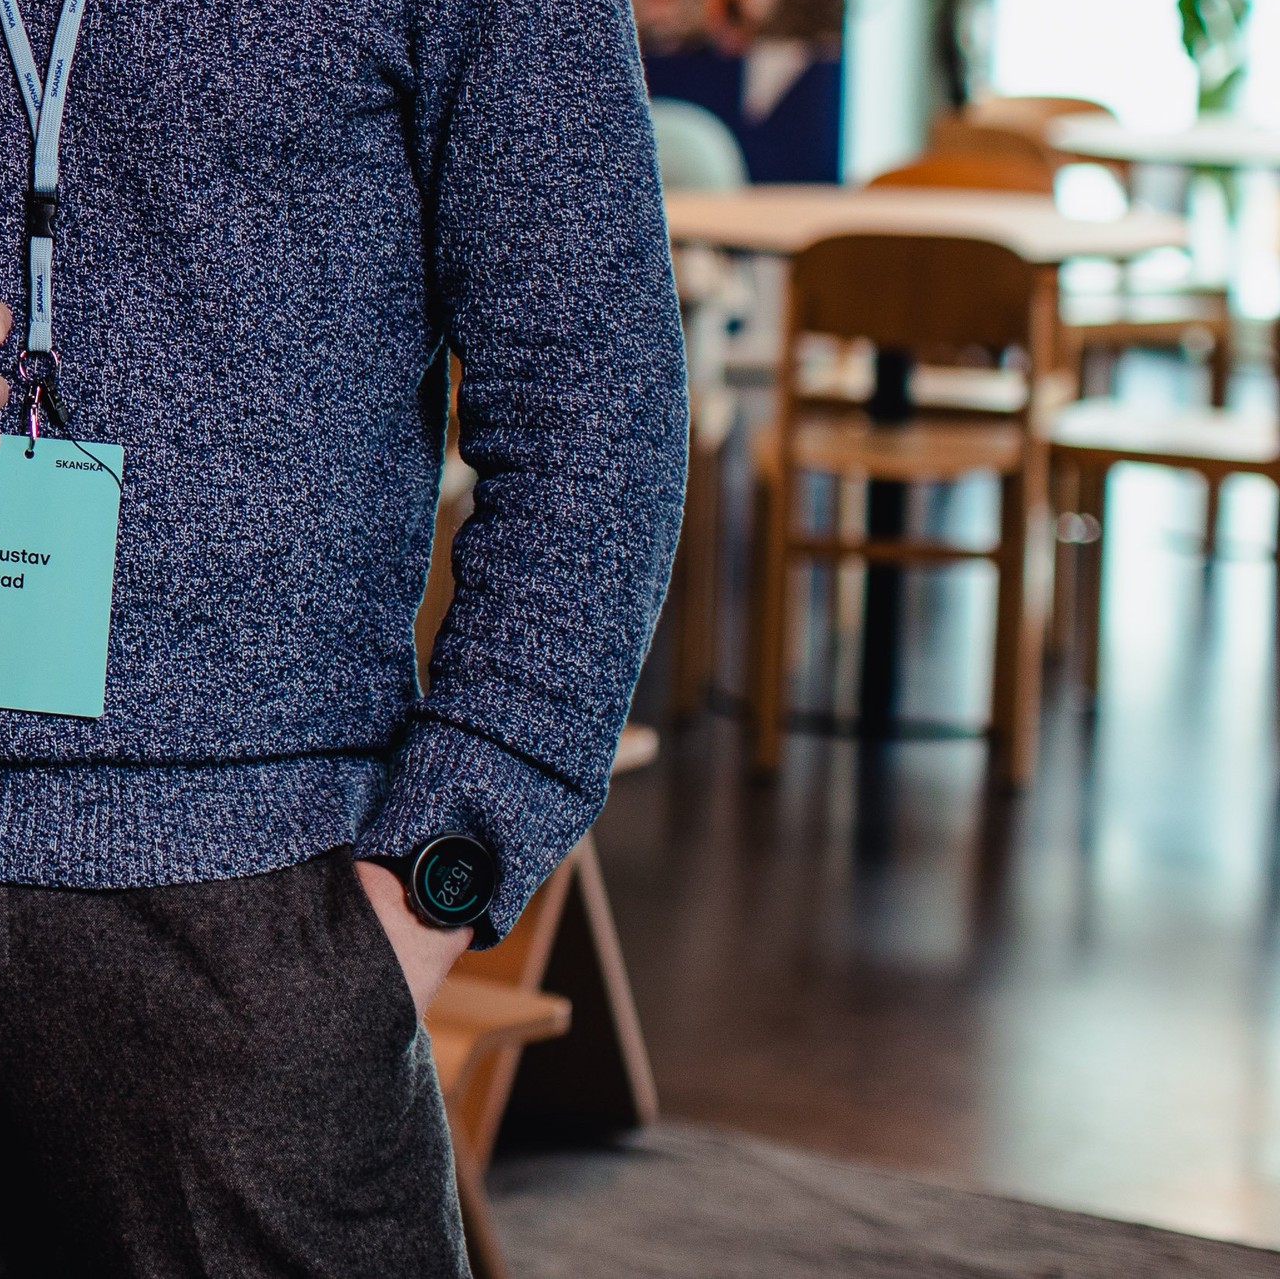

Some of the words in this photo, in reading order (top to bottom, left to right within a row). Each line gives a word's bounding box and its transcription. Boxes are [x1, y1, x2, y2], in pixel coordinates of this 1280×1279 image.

[24, 72, 41, 112] SKANSKA
[50, 59, 64, 97] SKANSKA
[36, 274, 44, 313] SKANSKA
[55, 459, 104, 472] SKANSKA
[436, 859, 473, 906] 15:32
